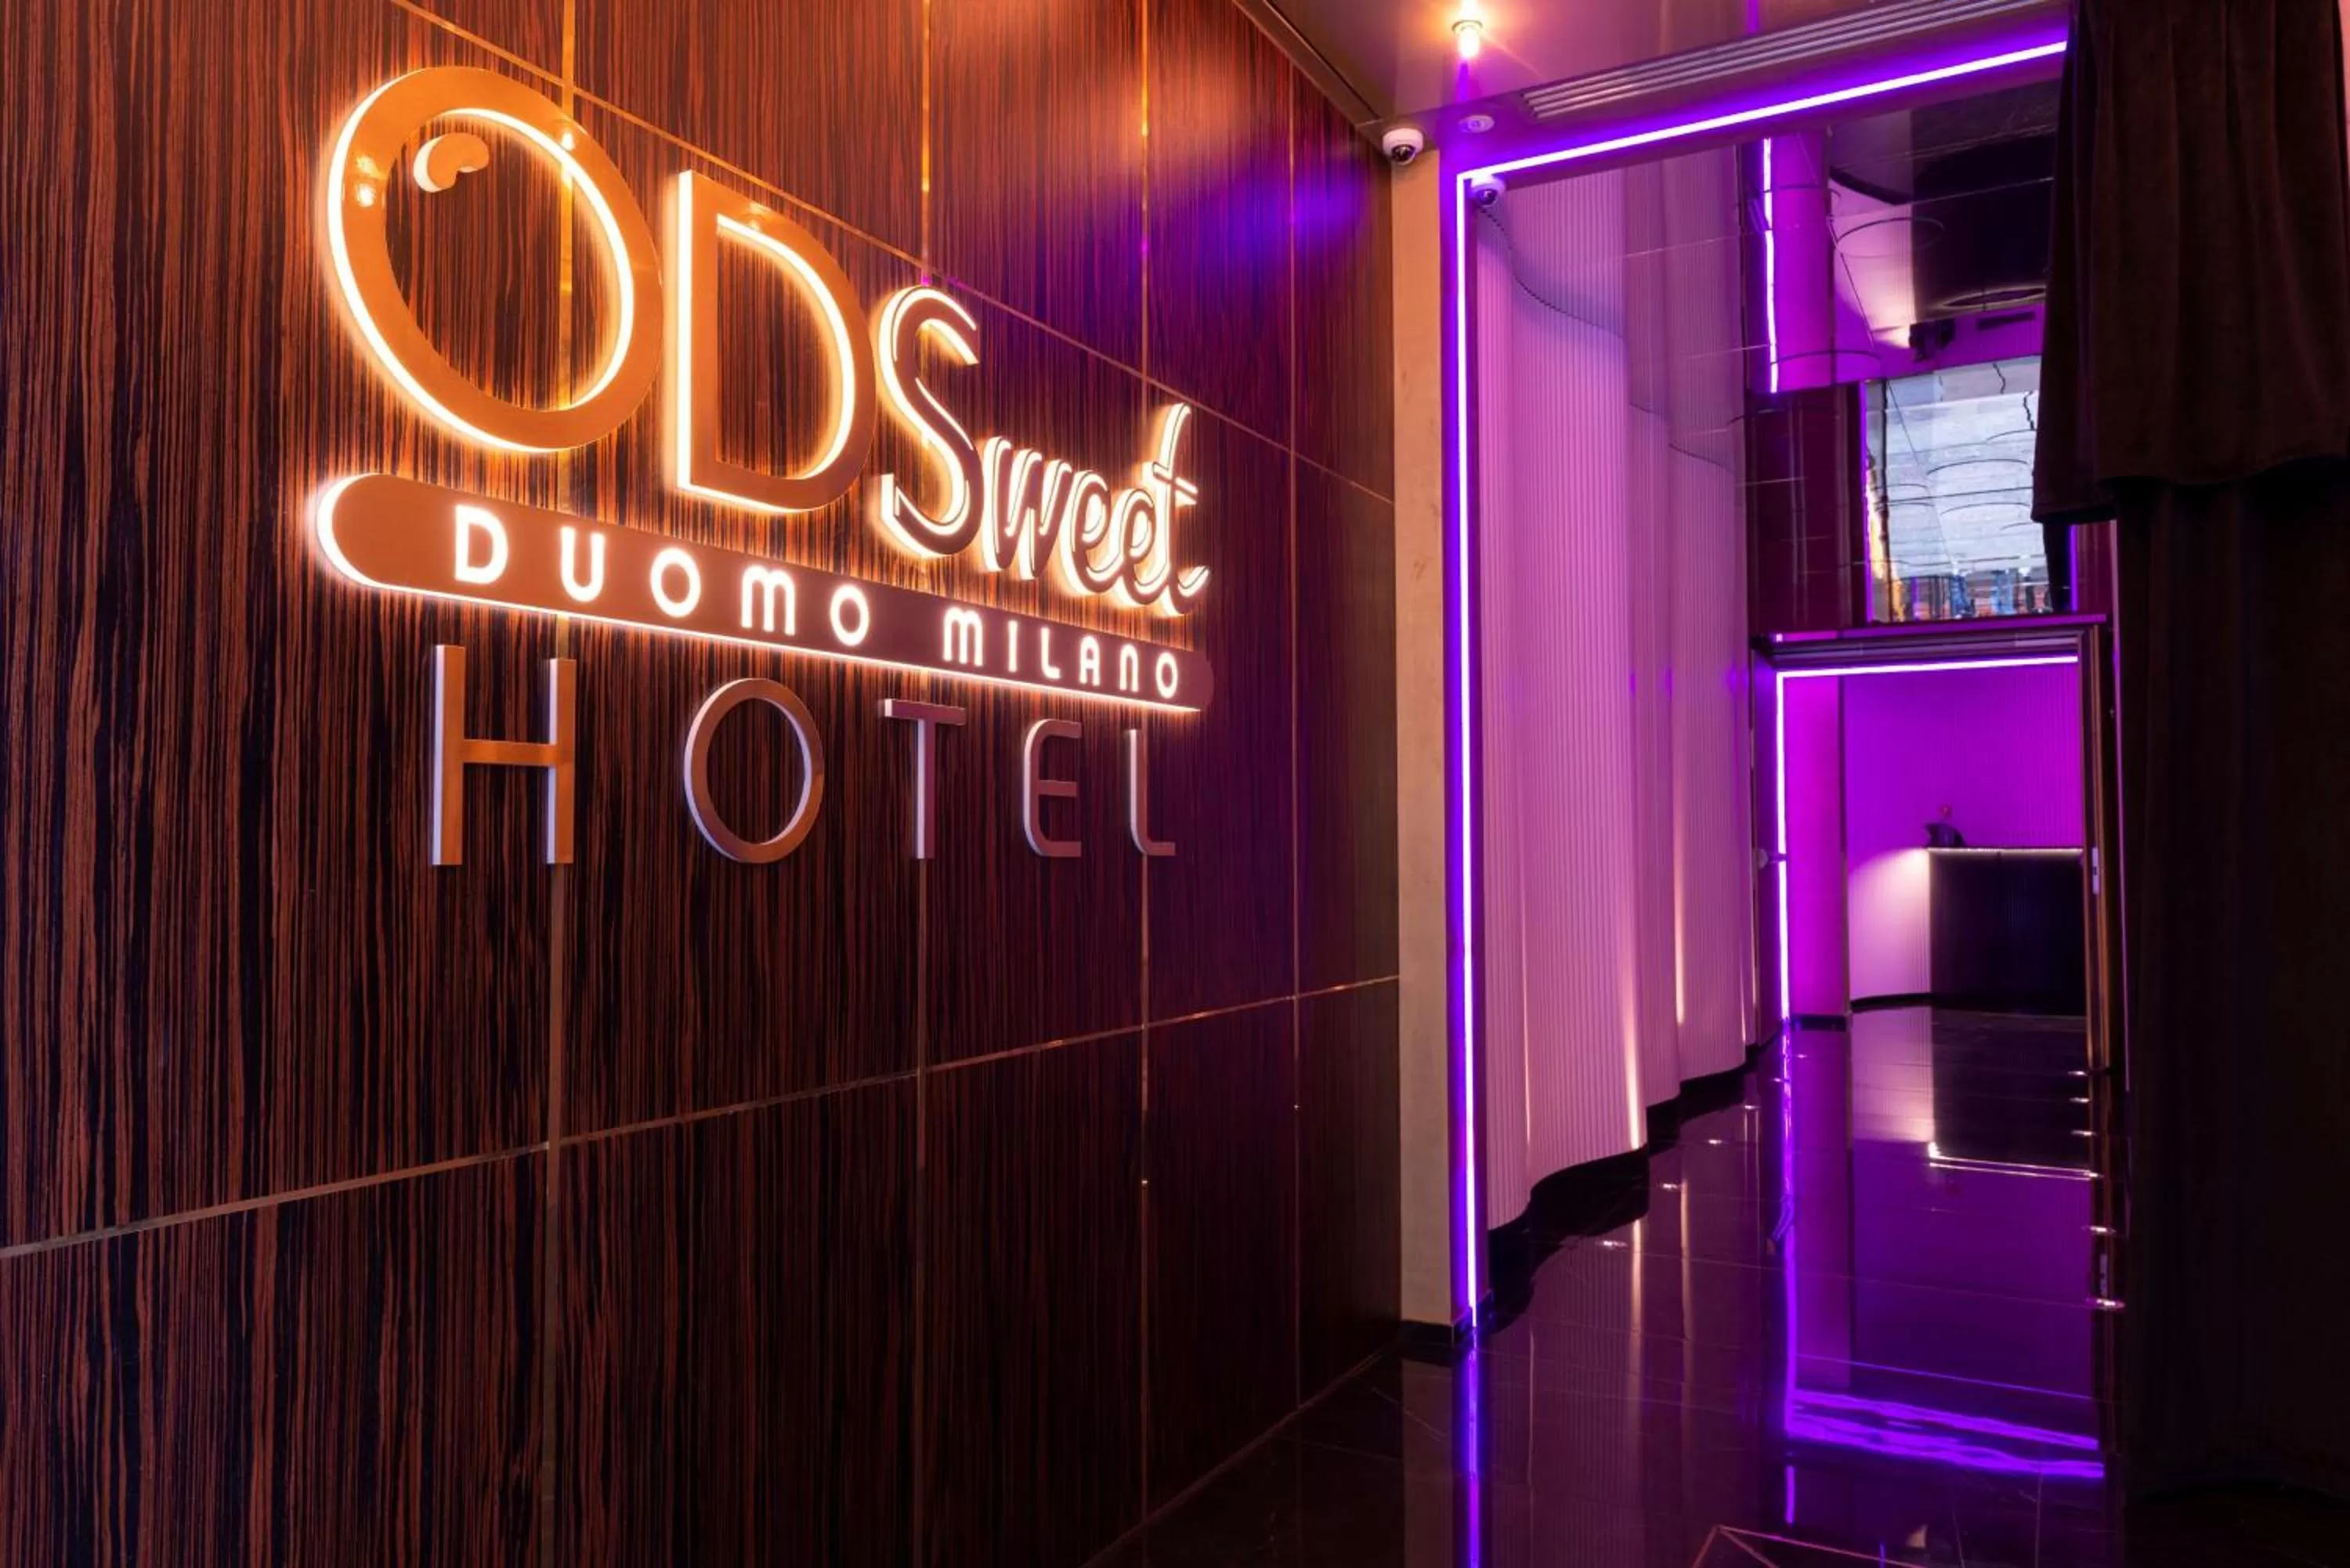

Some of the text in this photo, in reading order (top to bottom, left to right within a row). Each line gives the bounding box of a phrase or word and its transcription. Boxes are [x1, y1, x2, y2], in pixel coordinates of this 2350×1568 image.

[454, 504, 1179, 699] DUOMO MILANO
[432, 644, 1176, 865] HOTEL
